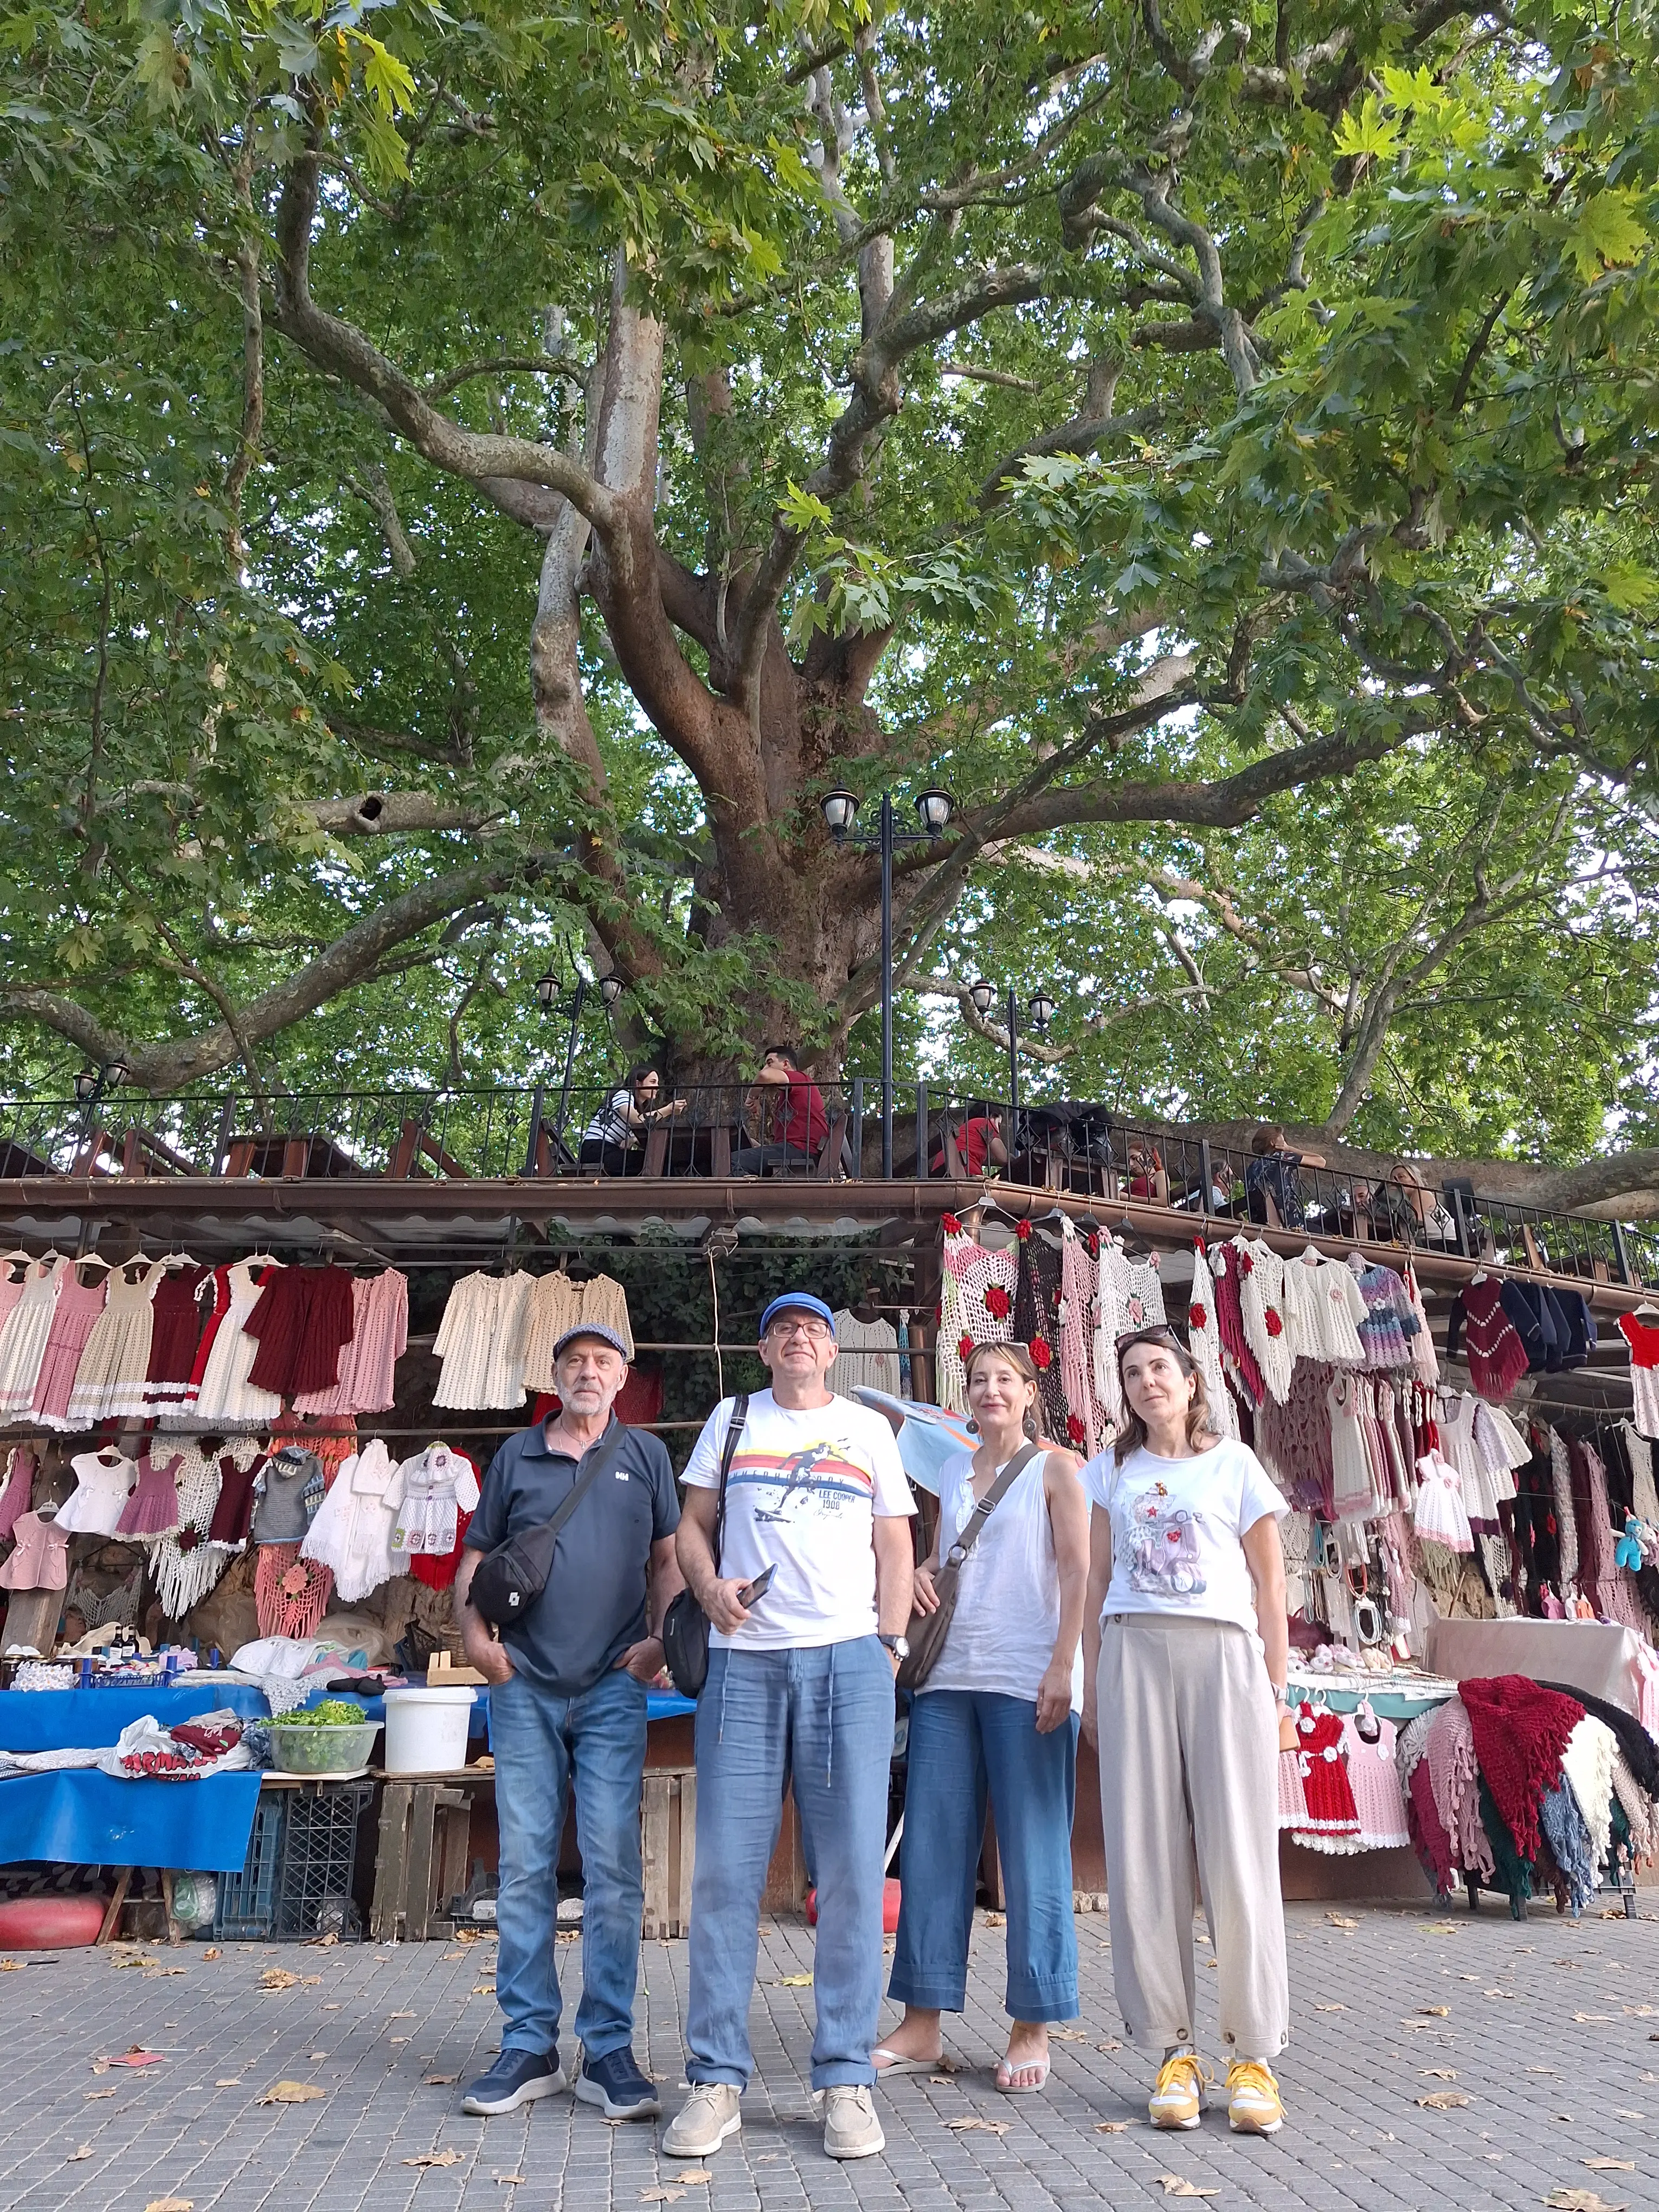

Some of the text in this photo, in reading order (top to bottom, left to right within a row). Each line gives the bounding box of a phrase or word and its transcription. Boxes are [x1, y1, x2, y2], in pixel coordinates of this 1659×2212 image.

[819, 1489, 856, 1503] LEE COOPER
[822, 1499, 840, 1510] 1908
